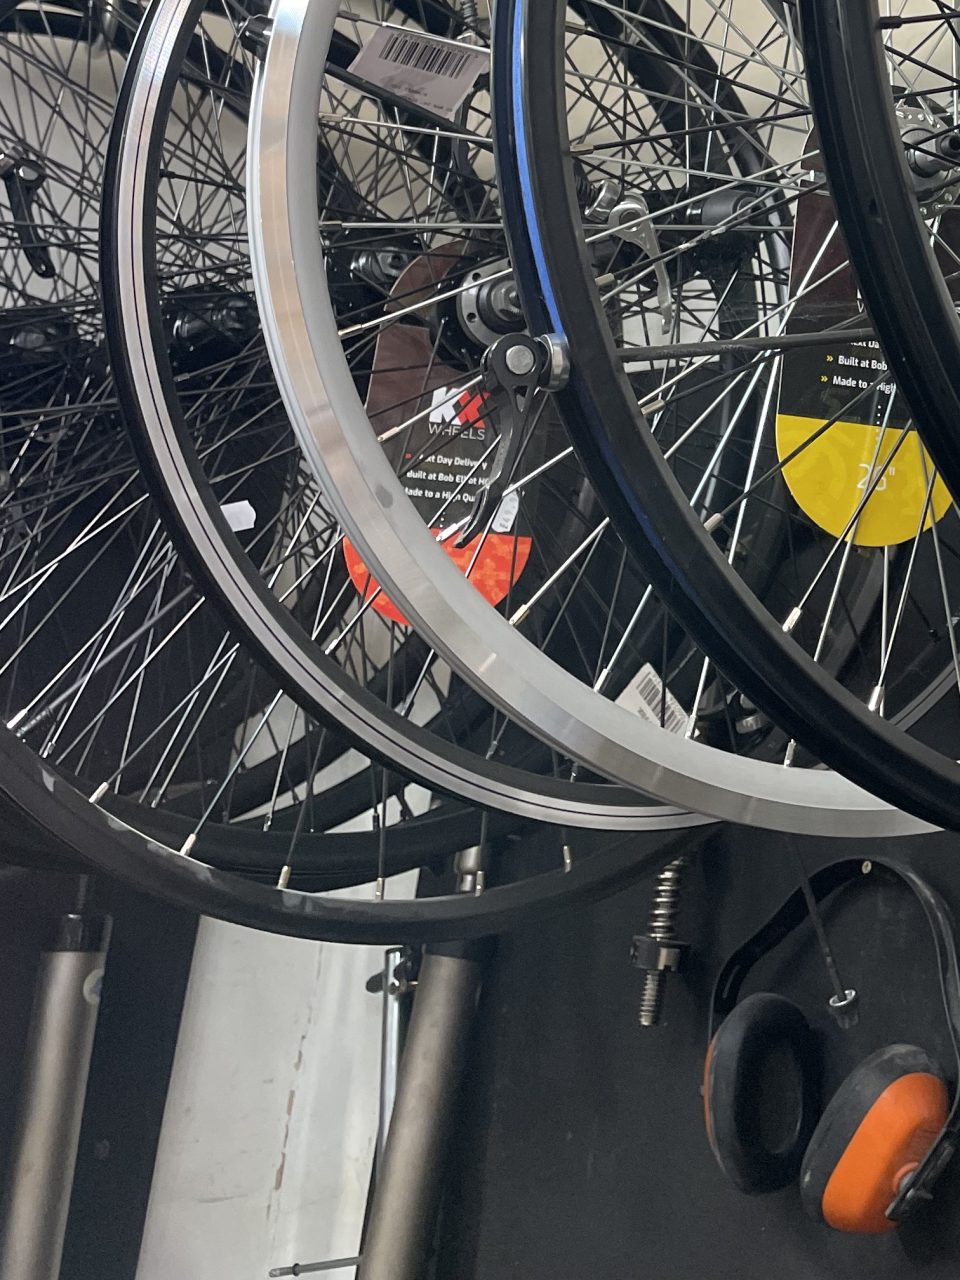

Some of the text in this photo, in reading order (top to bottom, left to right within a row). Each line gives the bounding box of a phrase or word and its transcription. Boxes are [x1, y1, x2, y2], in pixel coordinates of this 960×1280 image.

[838, 355, 888, 371] Built at Bob
[832, 375, 857, 388] Made
[858, 379, 868, 389] to
[428, 423, 486, 441] WHEELS
[437, 455, 453, 466] Day
[454, 457, 488, 470] Delivey
[438, 472, 454, 482] Bob
[424, 490, 433, 498] to
[442, 491, 461, 502] Hih
